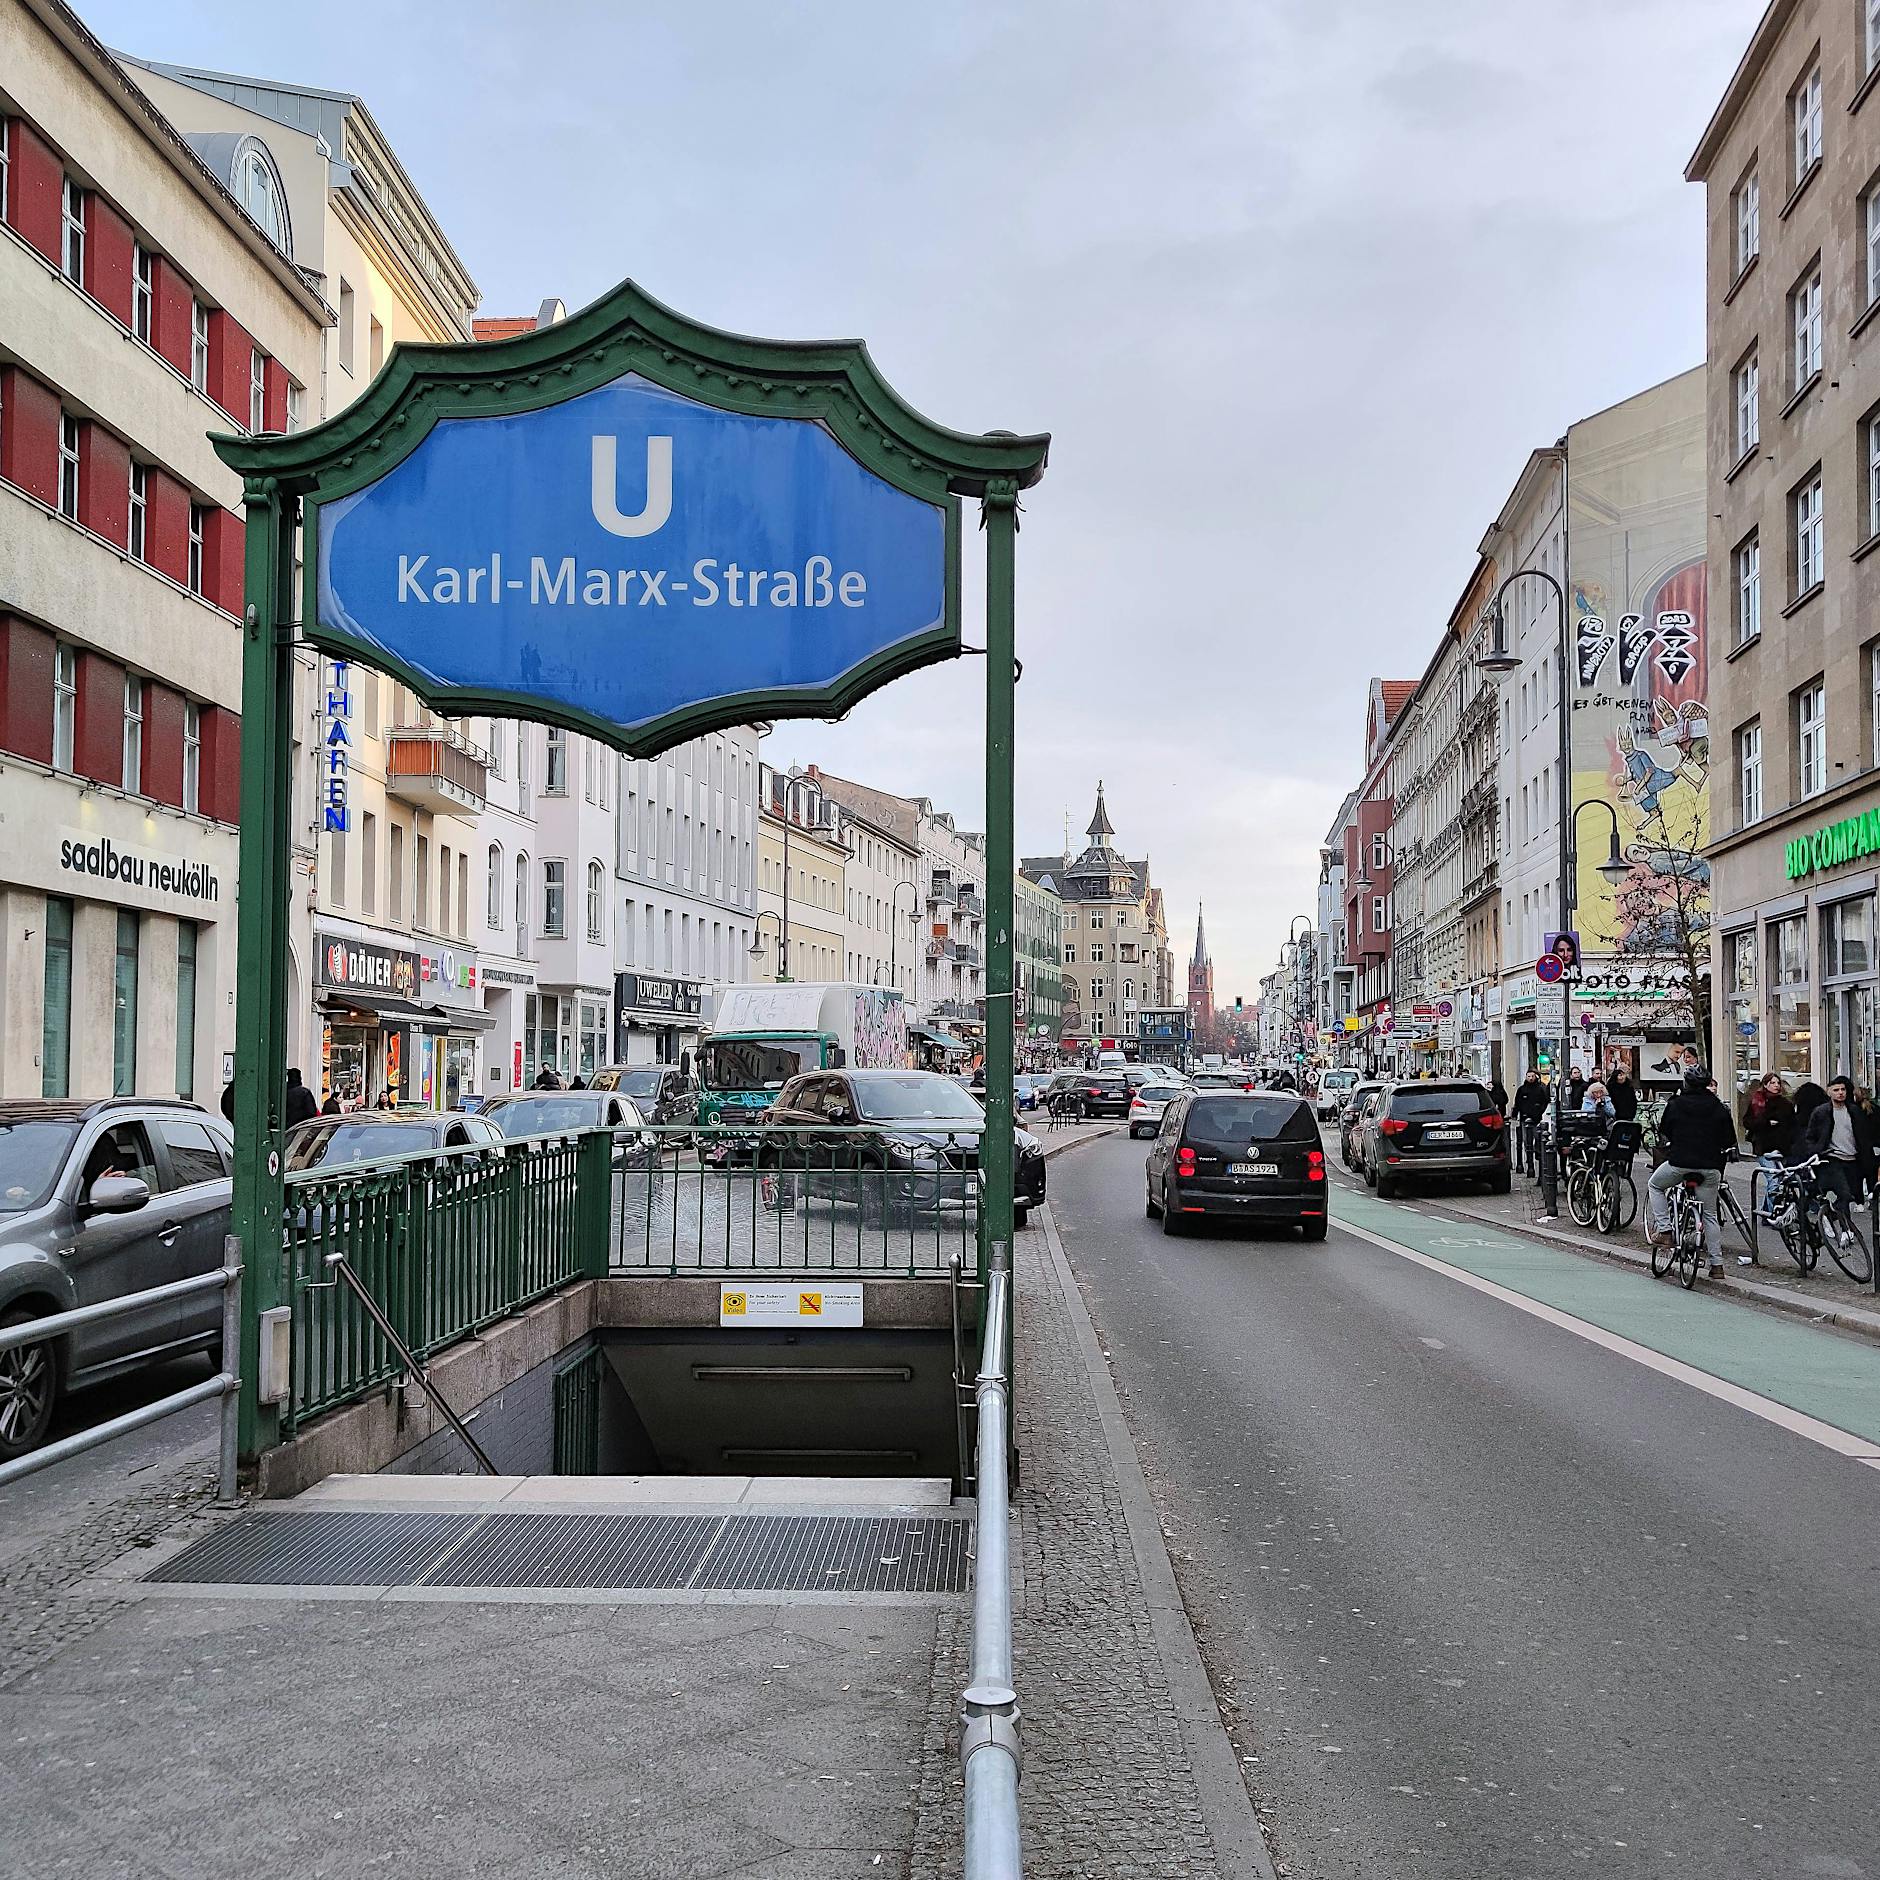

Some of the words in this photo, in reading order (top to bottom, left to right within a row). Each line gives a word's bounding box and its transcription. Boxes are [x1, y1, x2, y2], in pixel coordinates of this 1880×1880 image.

[592, 435, 673, 538] U
[398, 553, 867, 607] Karl-Marx-Straße
[61, 838, 144, 886] saalbau
[149, 859, 218, 901] neukölln
[1785, 835, 1812, 880] BIO
[349, 948, 391, 987] DÖNER
[1560, 964, 1582, 981] olt
[1579, 974, 1631, 989] OTO
[1642, 974, 1692, 989] FLAS
[636, 976, 673, 1005] JUWELIER
